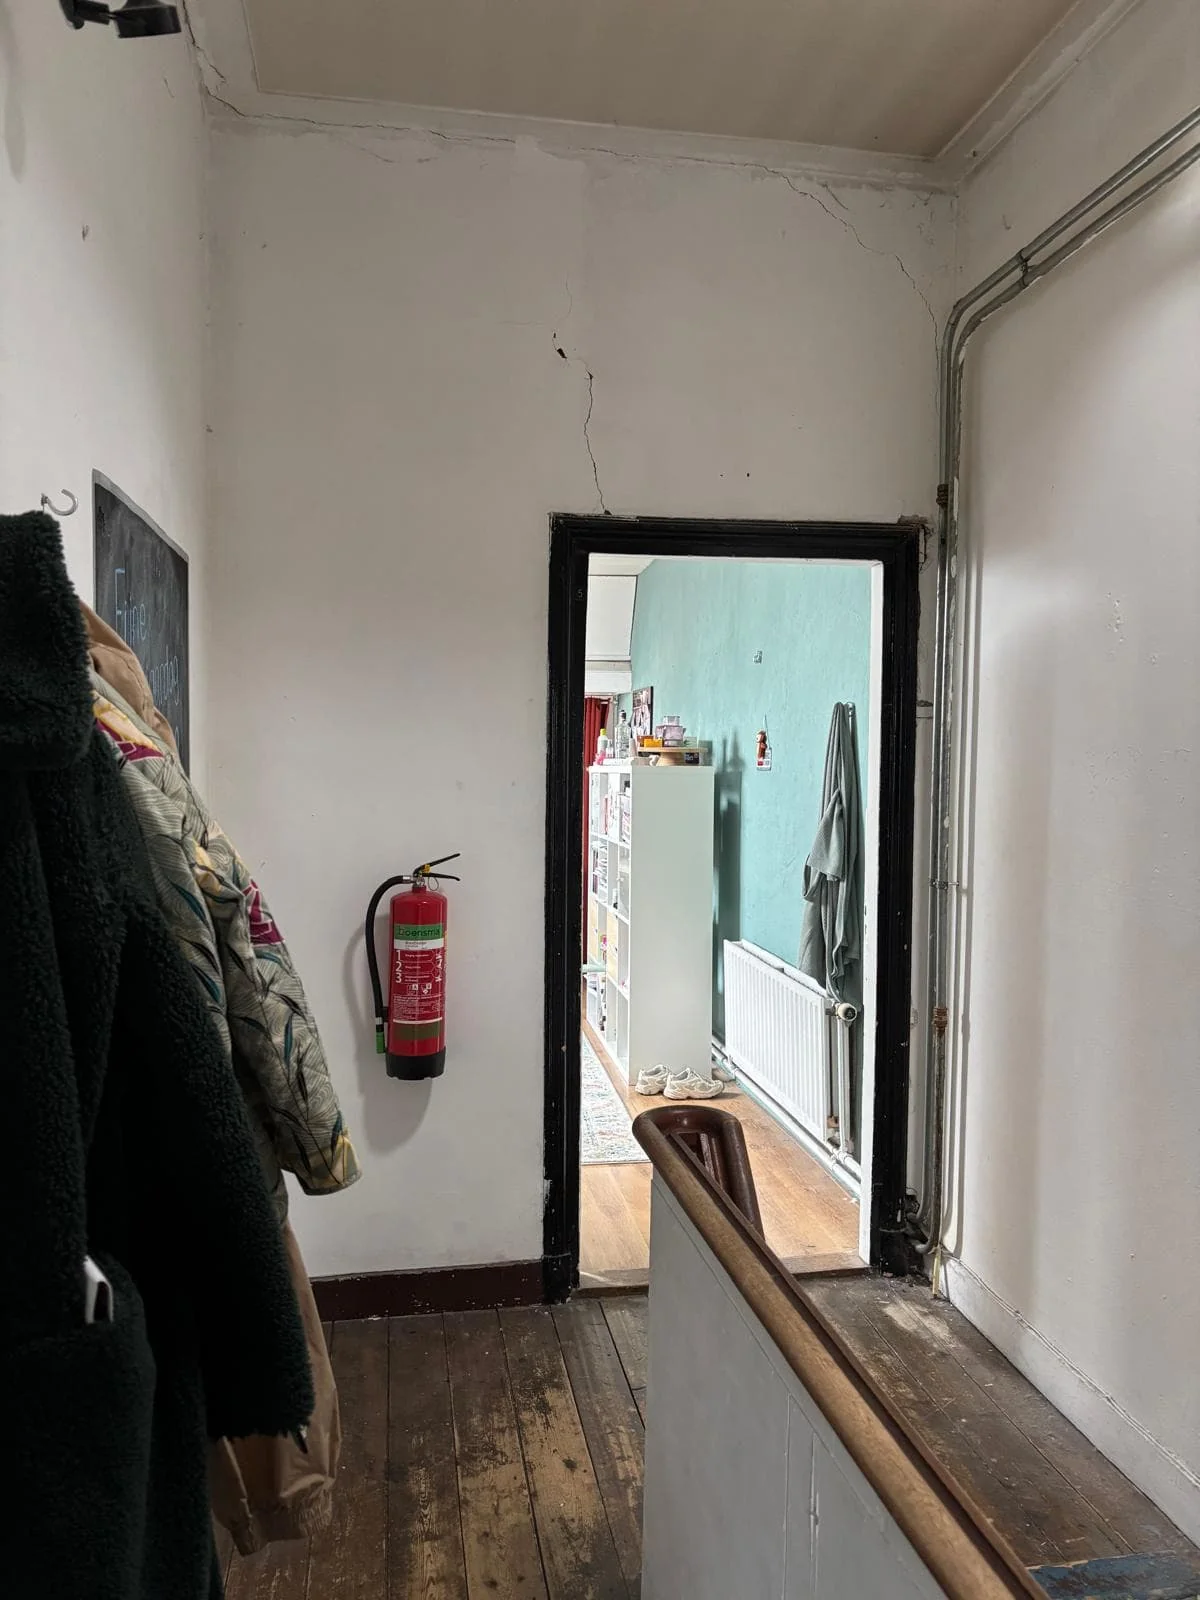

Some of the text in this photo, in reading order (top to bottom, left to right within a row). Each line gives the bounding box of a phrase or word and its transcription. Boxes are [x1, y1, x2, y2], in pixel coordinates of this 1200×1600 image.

[396, 949, 401, 960] 1
[395, 960, 402, 972] 2
[395, 972, 402, 983] 3
